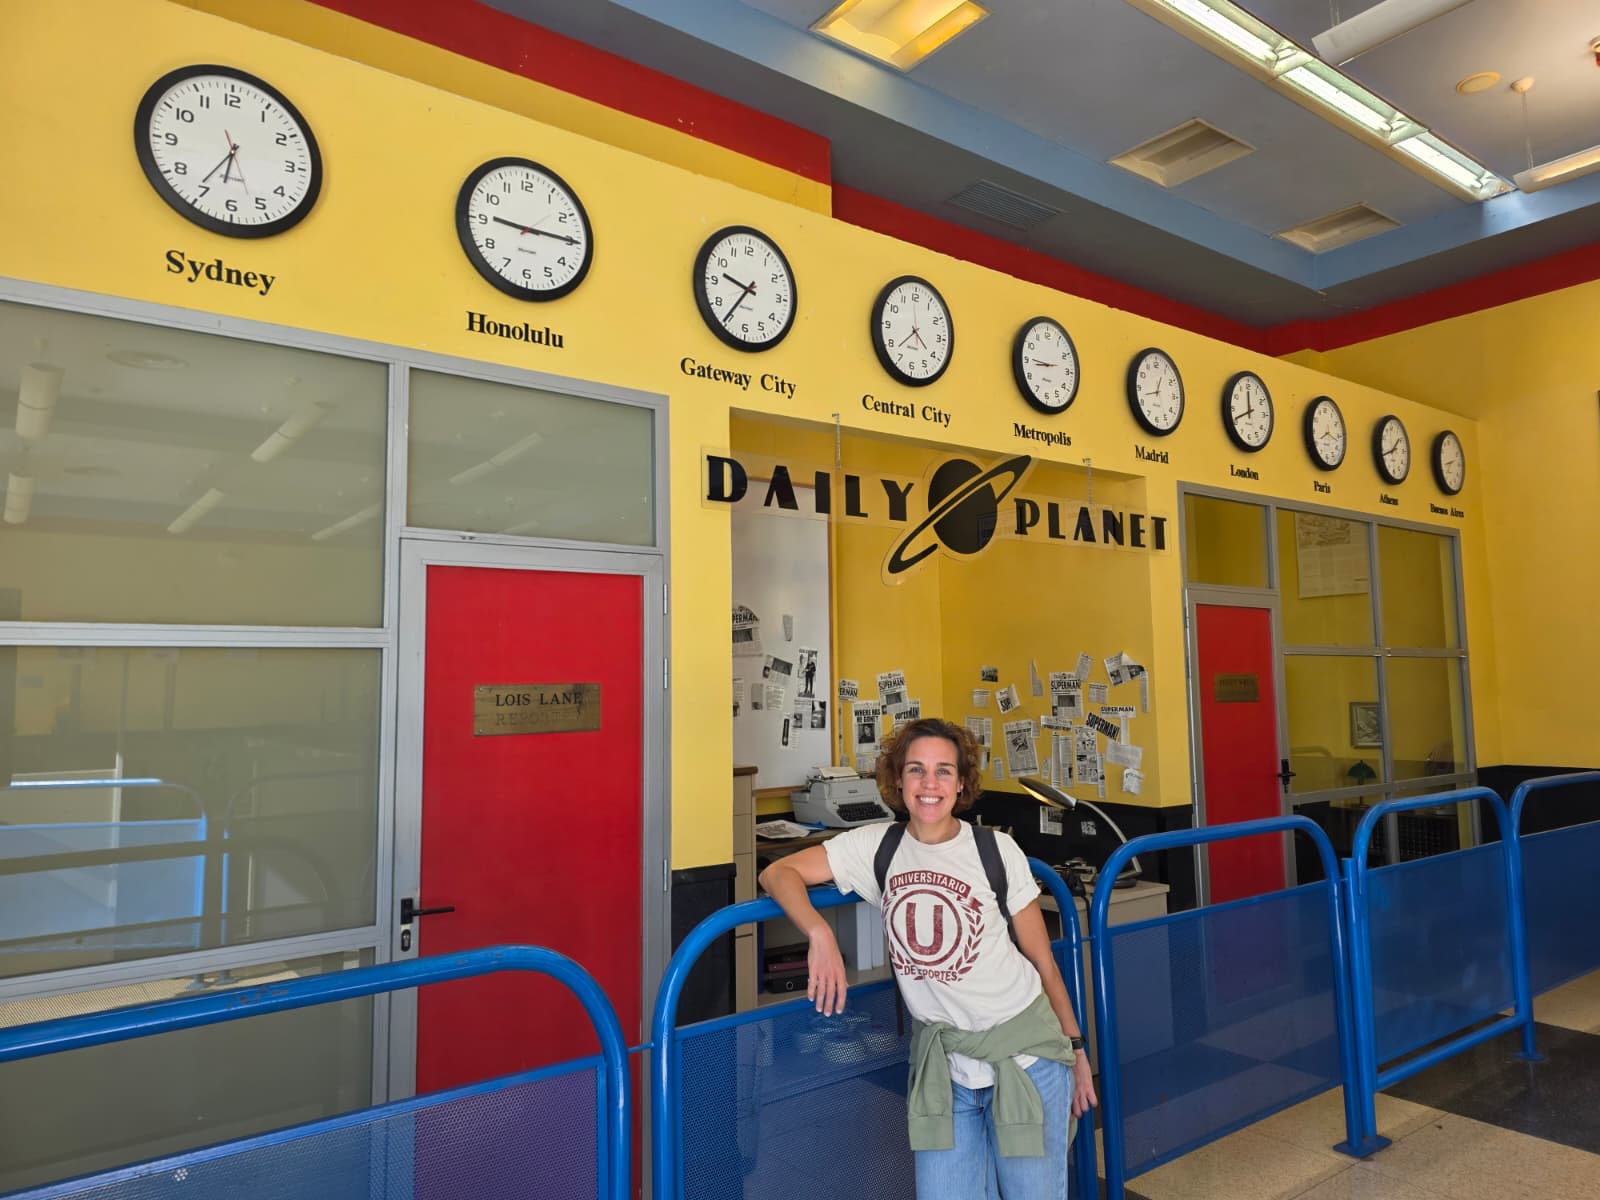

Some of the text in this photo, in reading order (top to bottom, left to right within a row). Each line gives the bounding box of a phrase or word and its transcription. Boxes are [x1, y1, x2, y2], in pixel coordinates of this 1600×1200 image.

[200, 95, 210, 109] 11
[224, 93, 241, 108] 12
[176, 108, 194, 123] 10
[261, 110, 265, 123] 1
[165, 132, 178, 146] 9
[276, 132, 287, 146] 2
[174, 162, 188, 175] 8
[284, 160, 296, 173] 3
[198, 185, 210, 198] 7
[273, 186, 286, 198] 4
[503, 182, 511, 194] 11
[520, 180, 534, 193] 12
[255, 198, 266, 210] 5
[486, 193, 500, 206] 10
[548, 194, 550, 204] 1
[225, 199, 238, 212] 6
[478, 214, 488, 224] 9
[558, 212, 568, 224] 2
[485, 238, 495, 249] 8
[730, 247, 736, 258] 11
[744, 246, 754, 256] 12
[502, 257, 512, 268] 7
[557, 256, 566, 266] 4
[717, 257, 728, 268] 10
[166, 250, 276, 296] Sydney
[522, 268, 532, 280] 6
[544, 266, 552, 278] 5
[711, 275, 718, 286] 9
[771, 274, 778, 284] 2
[715, 296, 722, 306] 8
[776, 294, 782, 304] 3
[900, 295, 906, 304] 11
[912, 293, 920, 302] 12
[890, 304, 898, 314] 10
[768, 312, 776, 320] 4
[932, 316, 938, 326] 2
[466, 310, 564, 348] Honolulu
[742, 324, 748, 333] 6
[758, 322, 764, 331] 5
[885, 320, 891, 329] 9
[888, 339, 894, 348] 8
[936, 334, 942, 343] 3
[898, 353, 904, 362] 7
[909, 361, 915, 370] 6
[922, 360, 928, 368] 5
[680, 357, 796, 398] Gateway City
[862, 394, 952, 428] Central City
[1013, 422, 1072, 446] Metropolis
[1135, 444, 1168, 464] Madrid
[1230, 464, 1258, 480] London
[1314, 480, 1331, 494] Paris
[706, 454, 1168, 550] DAILY PLANET
[1380, 494, 1398, 506] Athens
[496, 692, 584, 707] LOIS LANE
[892, 872, 966, 894] UNIVERSITARIO
[906, 902, 944, 956] U
